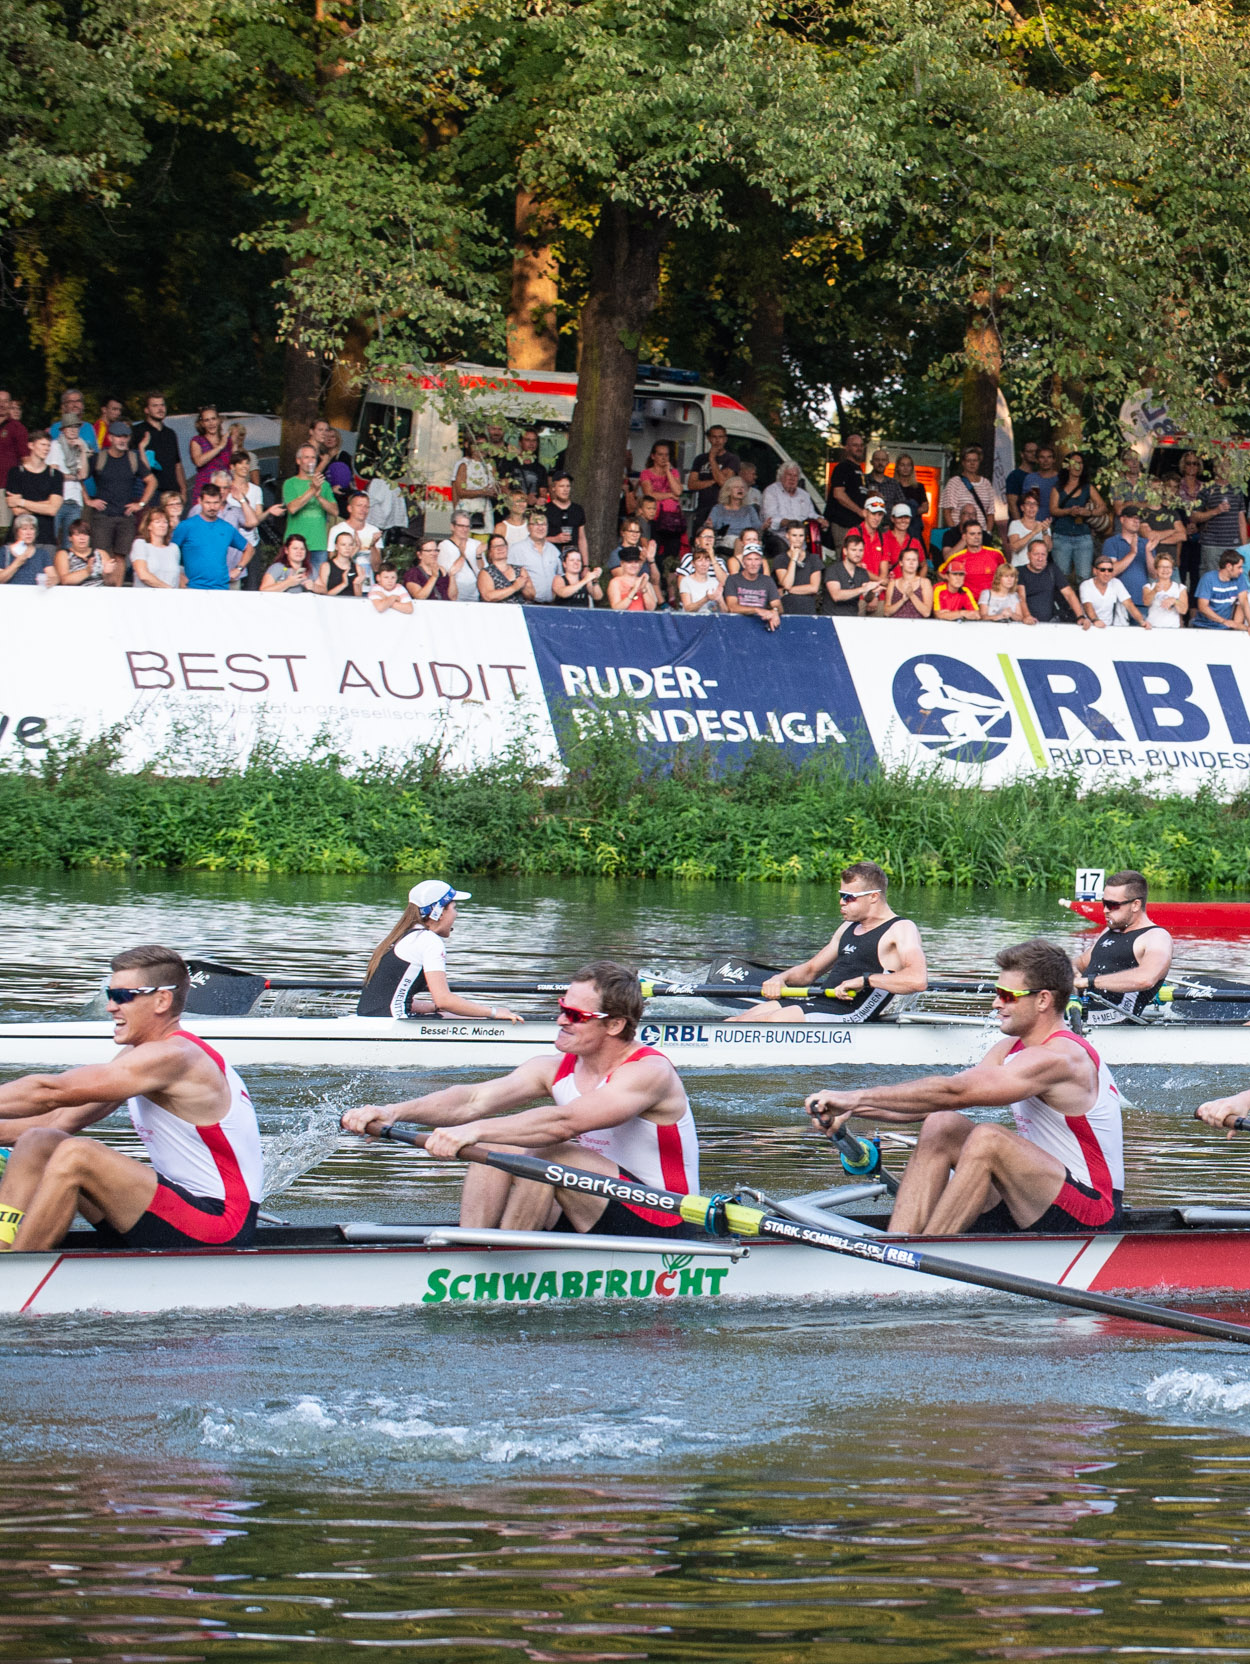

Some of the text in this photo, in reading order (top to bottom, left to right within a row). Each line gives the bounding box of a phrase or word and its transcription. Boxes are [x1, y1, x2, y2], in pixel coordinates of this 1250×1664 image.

[126, 651, 527, 701] BEST AUDIT
[560, 664, 718, 699] RUDER-
[1079, 873, 1101, 891] 17
[420, 1026, 505, 1036] Bessel-R.C. Minden
[664, 1025, 709, 1042] RBL
[714, 1029, 852, 1044] RUDER-BUNDESLIGA
[545, 1165, 675, 1210] Sparkasse
[763, 1220, 801, 1238] STARK.
[887, 1247, 916, 1265] RBL
[422, 1266, 729, 1303] SCHWABFRUCHT
